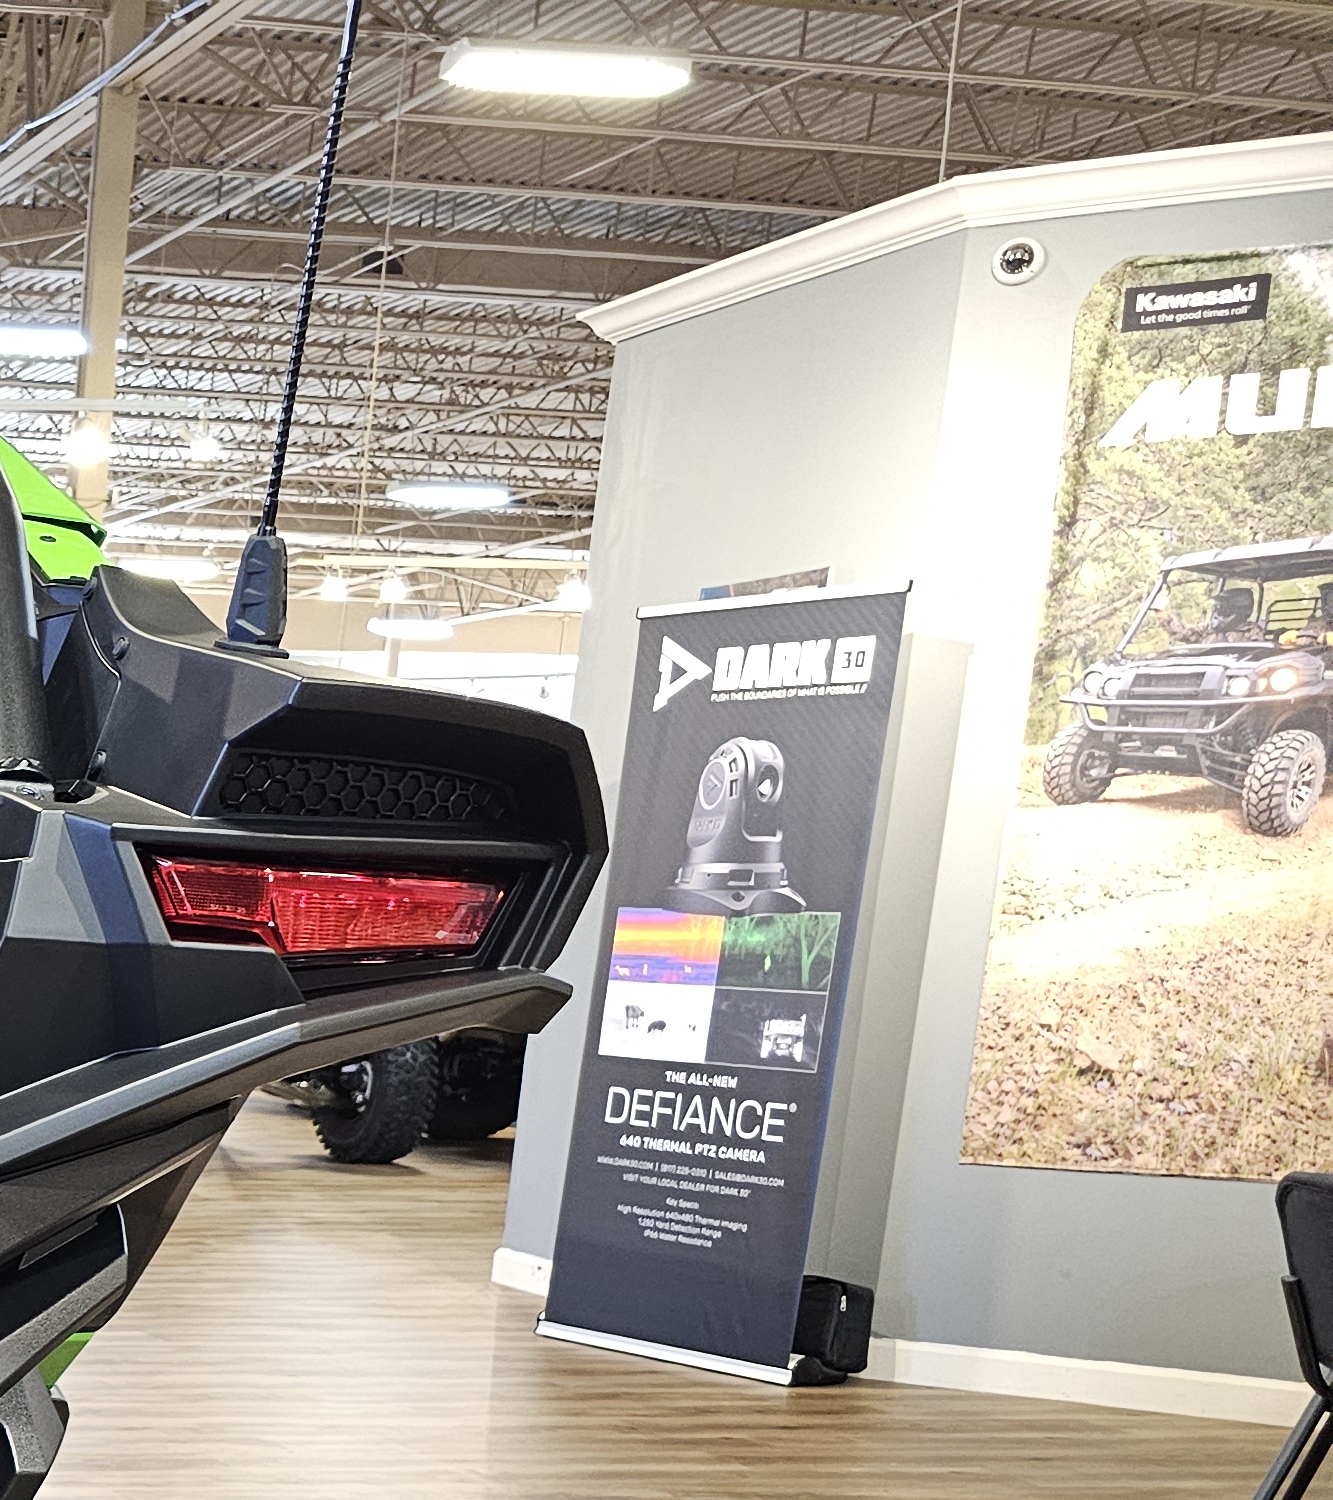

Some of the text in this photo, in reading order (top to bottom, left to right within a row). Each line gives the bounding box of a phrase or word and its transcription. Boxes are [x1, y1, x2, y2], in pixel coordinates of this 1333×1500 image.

[1135, 282, 1258, 313] Kawasaki
[1140, 315, 1156, 325] Let
[1158, 313, 1174, 323] the
[1175, 310, 1201, 323] good
[1202, 309, 1230, 318] times
[711, 638, 866, 692] DARK 30
[664, 1070, 738, 1089] THE ALL-NEW
[619, 1134, 766, 1164] 640 THERMAL PTZ CAMERA
